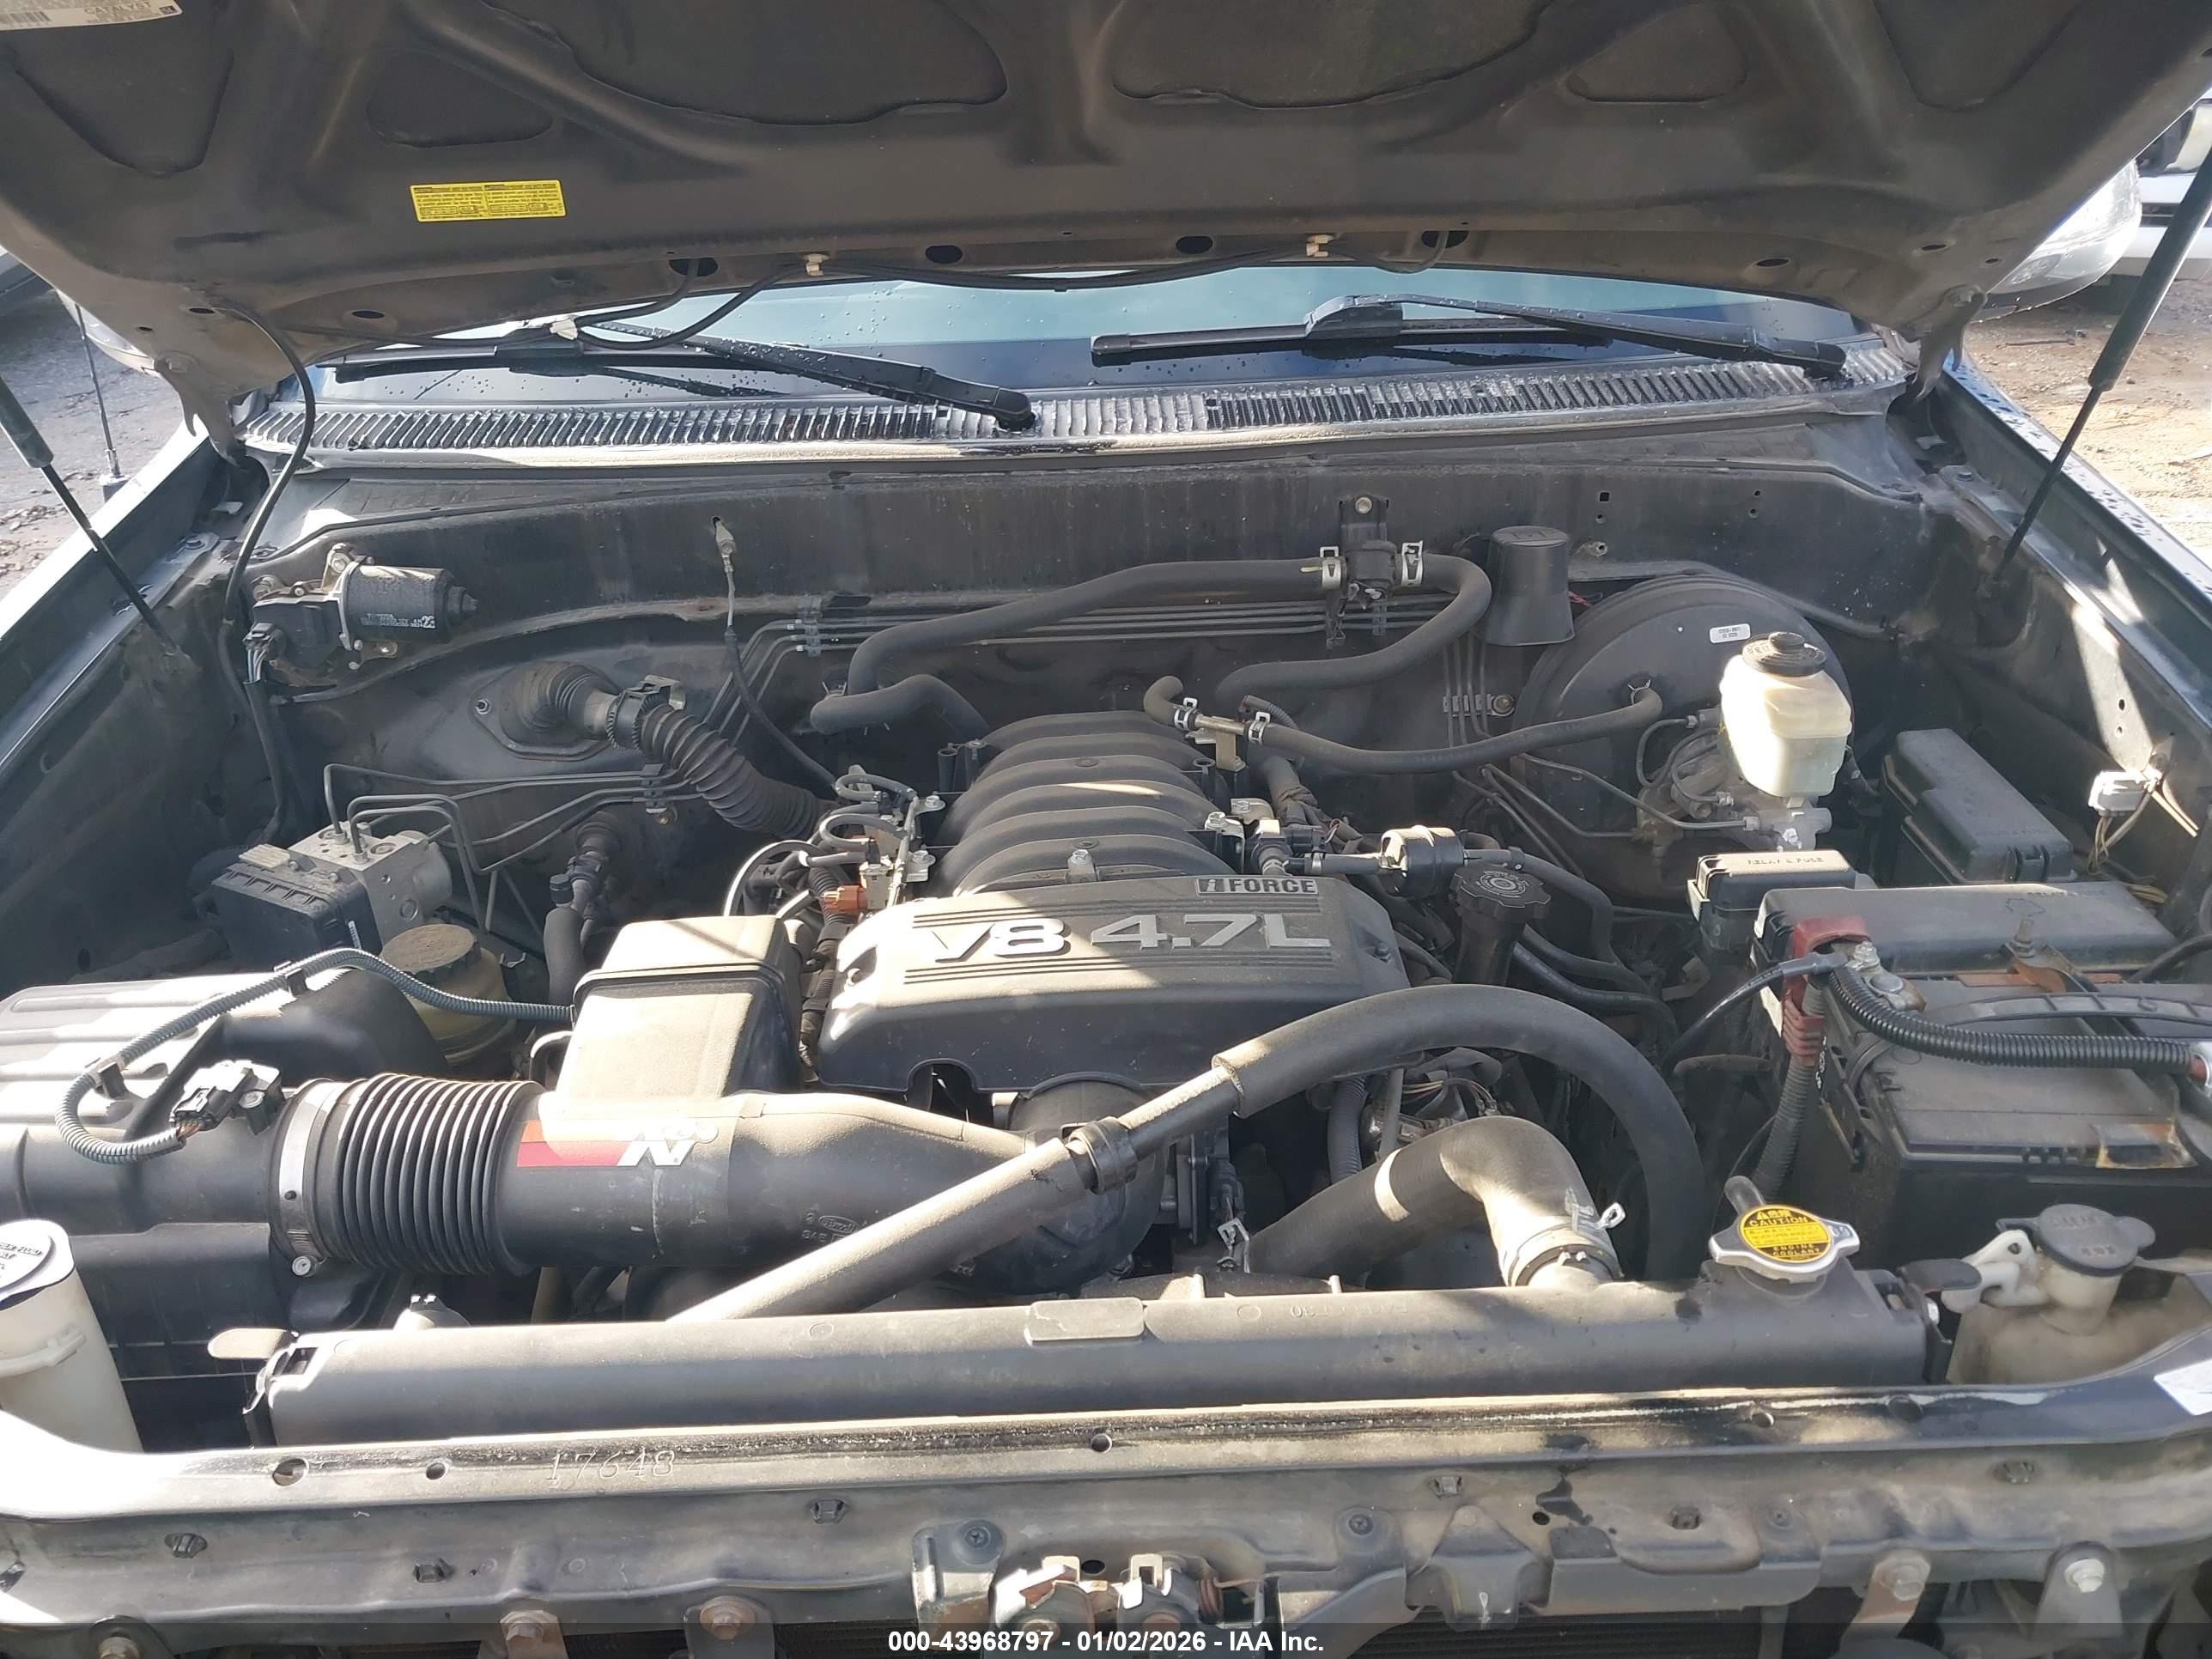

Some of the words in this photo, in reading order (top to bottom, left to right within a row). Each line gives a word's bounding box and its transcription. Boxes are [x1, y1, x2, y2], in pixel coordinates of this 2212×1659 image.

[84, 1, 152, 15] CATALYST
[1228, 878, 1316, 893] FORCE
[923, 917, 1072, 963] V8
[1091, 914, 1331, 950] 4.7L
[1748, 1215, 1808, 1227] CAUTION
[546, 1446, 675, 1480] 17648
